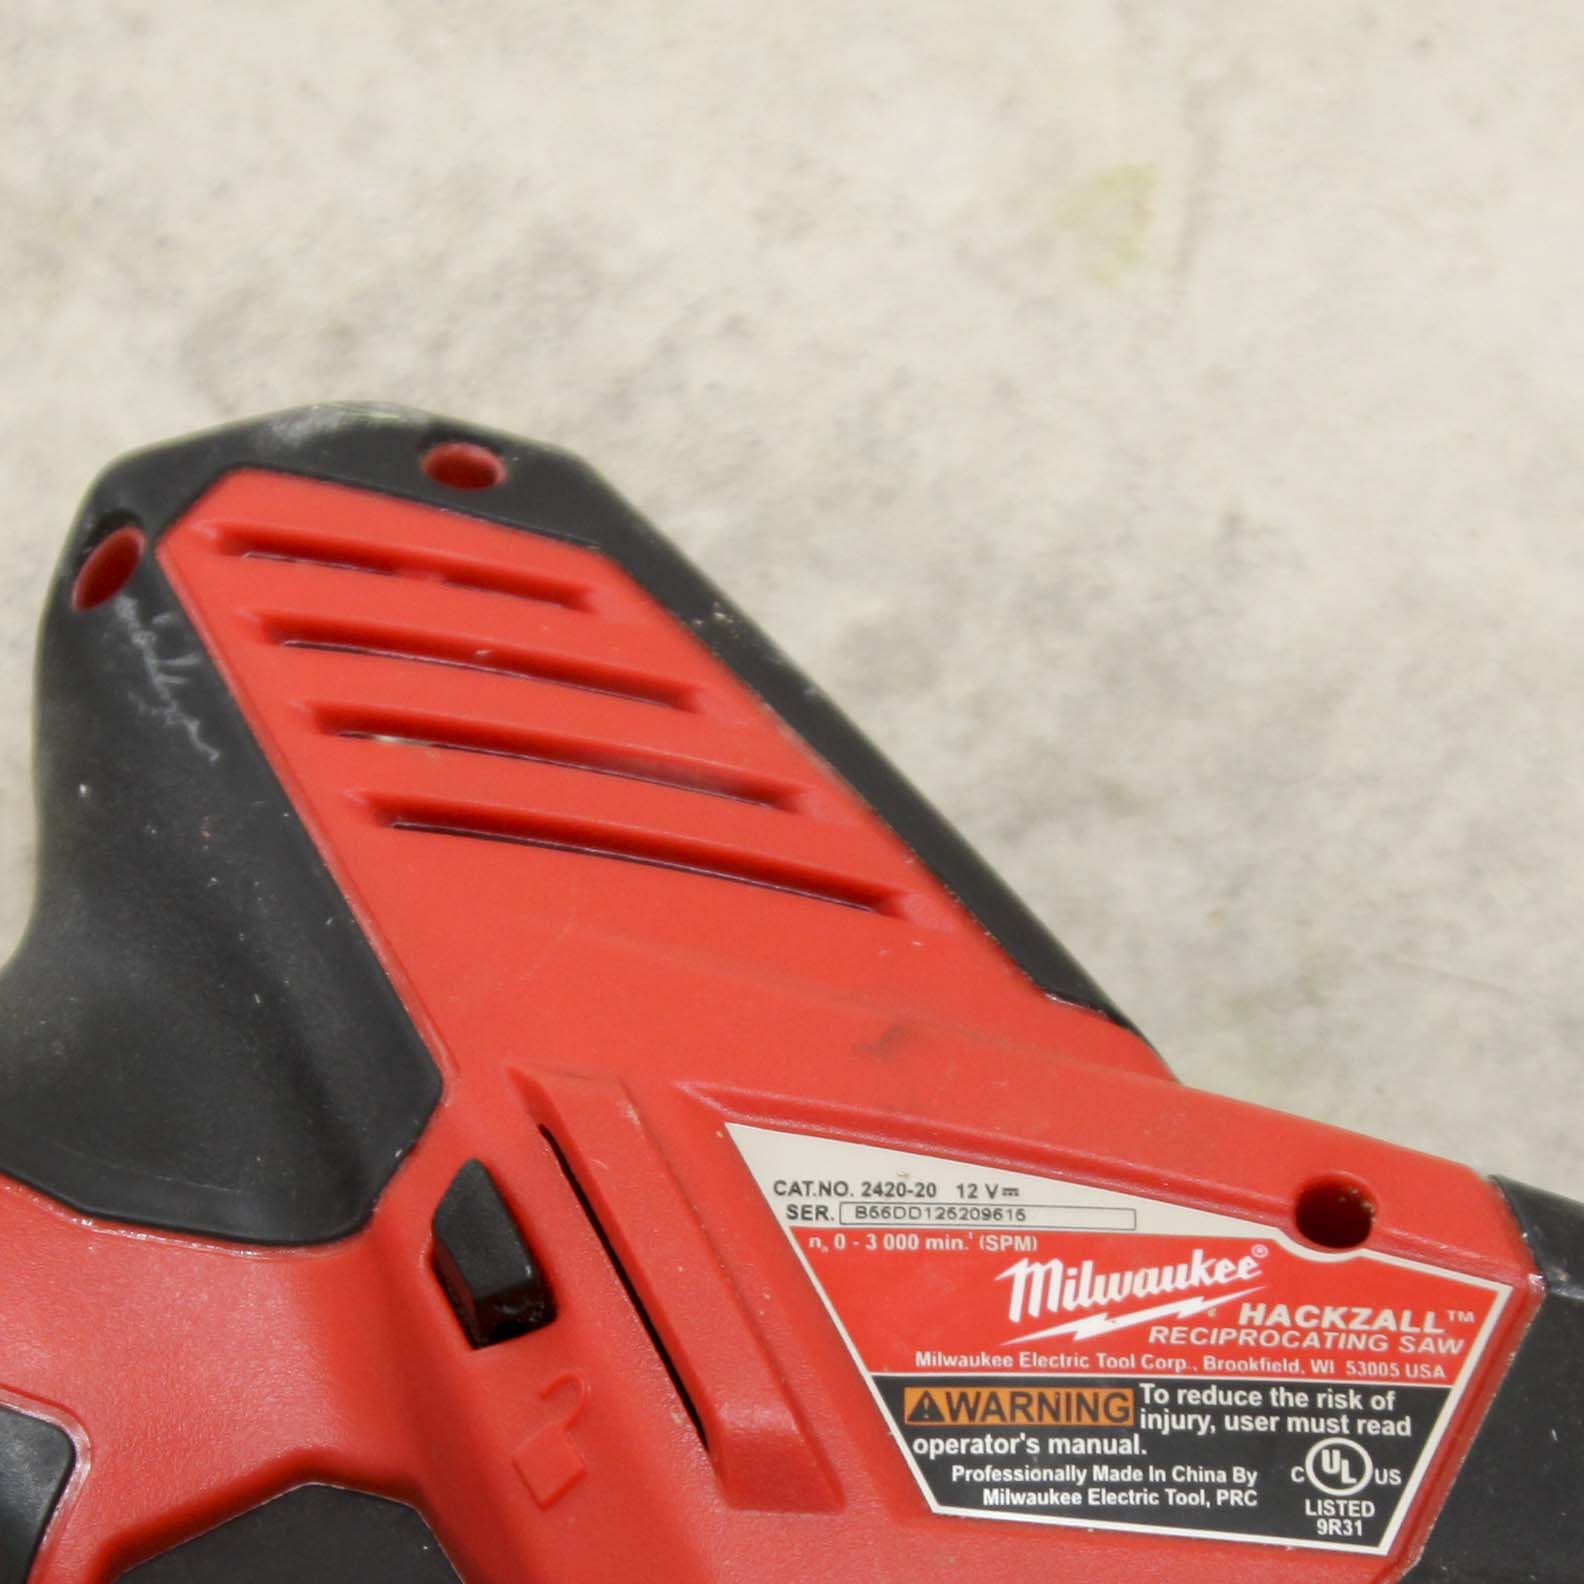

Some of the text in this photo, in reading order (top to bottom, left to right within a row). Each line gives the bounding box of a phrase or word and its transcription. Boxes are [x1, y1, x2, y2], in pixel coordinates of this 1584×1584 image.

[861, 1181, 937, 1197] 2420-20
[957, 1183, 979, 1198] 12
[786, 1204, 834, 1221] SER.
[866, 1234, 877, 1250] 3
[883, 1234, 920, 1250] 000
[979, 1235, 1037, 1252] (SPM)
[1149, 1326, 1464, 1355] RECIPROCATING SAW
[915, 1352, 1013, 1368] Milwaukee
[1019, 1352, 1090, 1368] Electric
[1097, 1353, 1135, 1369] Tool
[1311, 1359, 1334, 1375] WI
[1345, 1362, 1400, 1377] 53005
[1405, 1363, 1446, 1379] USA
[945, 1391, 1130, 1423] WARNING
[1139, 1383, 1396, 1411] To reduce the risk of
[1140, 1409, 1411, 1436] injury, user must read
[912, 1432, 1147, 1459] operator's manual.
[951, 1465, 1258, 1486] Professionally Made In China By
[983, 1488, 1258, 1507] Milwaukee Electric Tool, PRC
[1305, 1499, 1375, 1517] LISTED
[1316, 1518, 1363, 1536] 9R31
